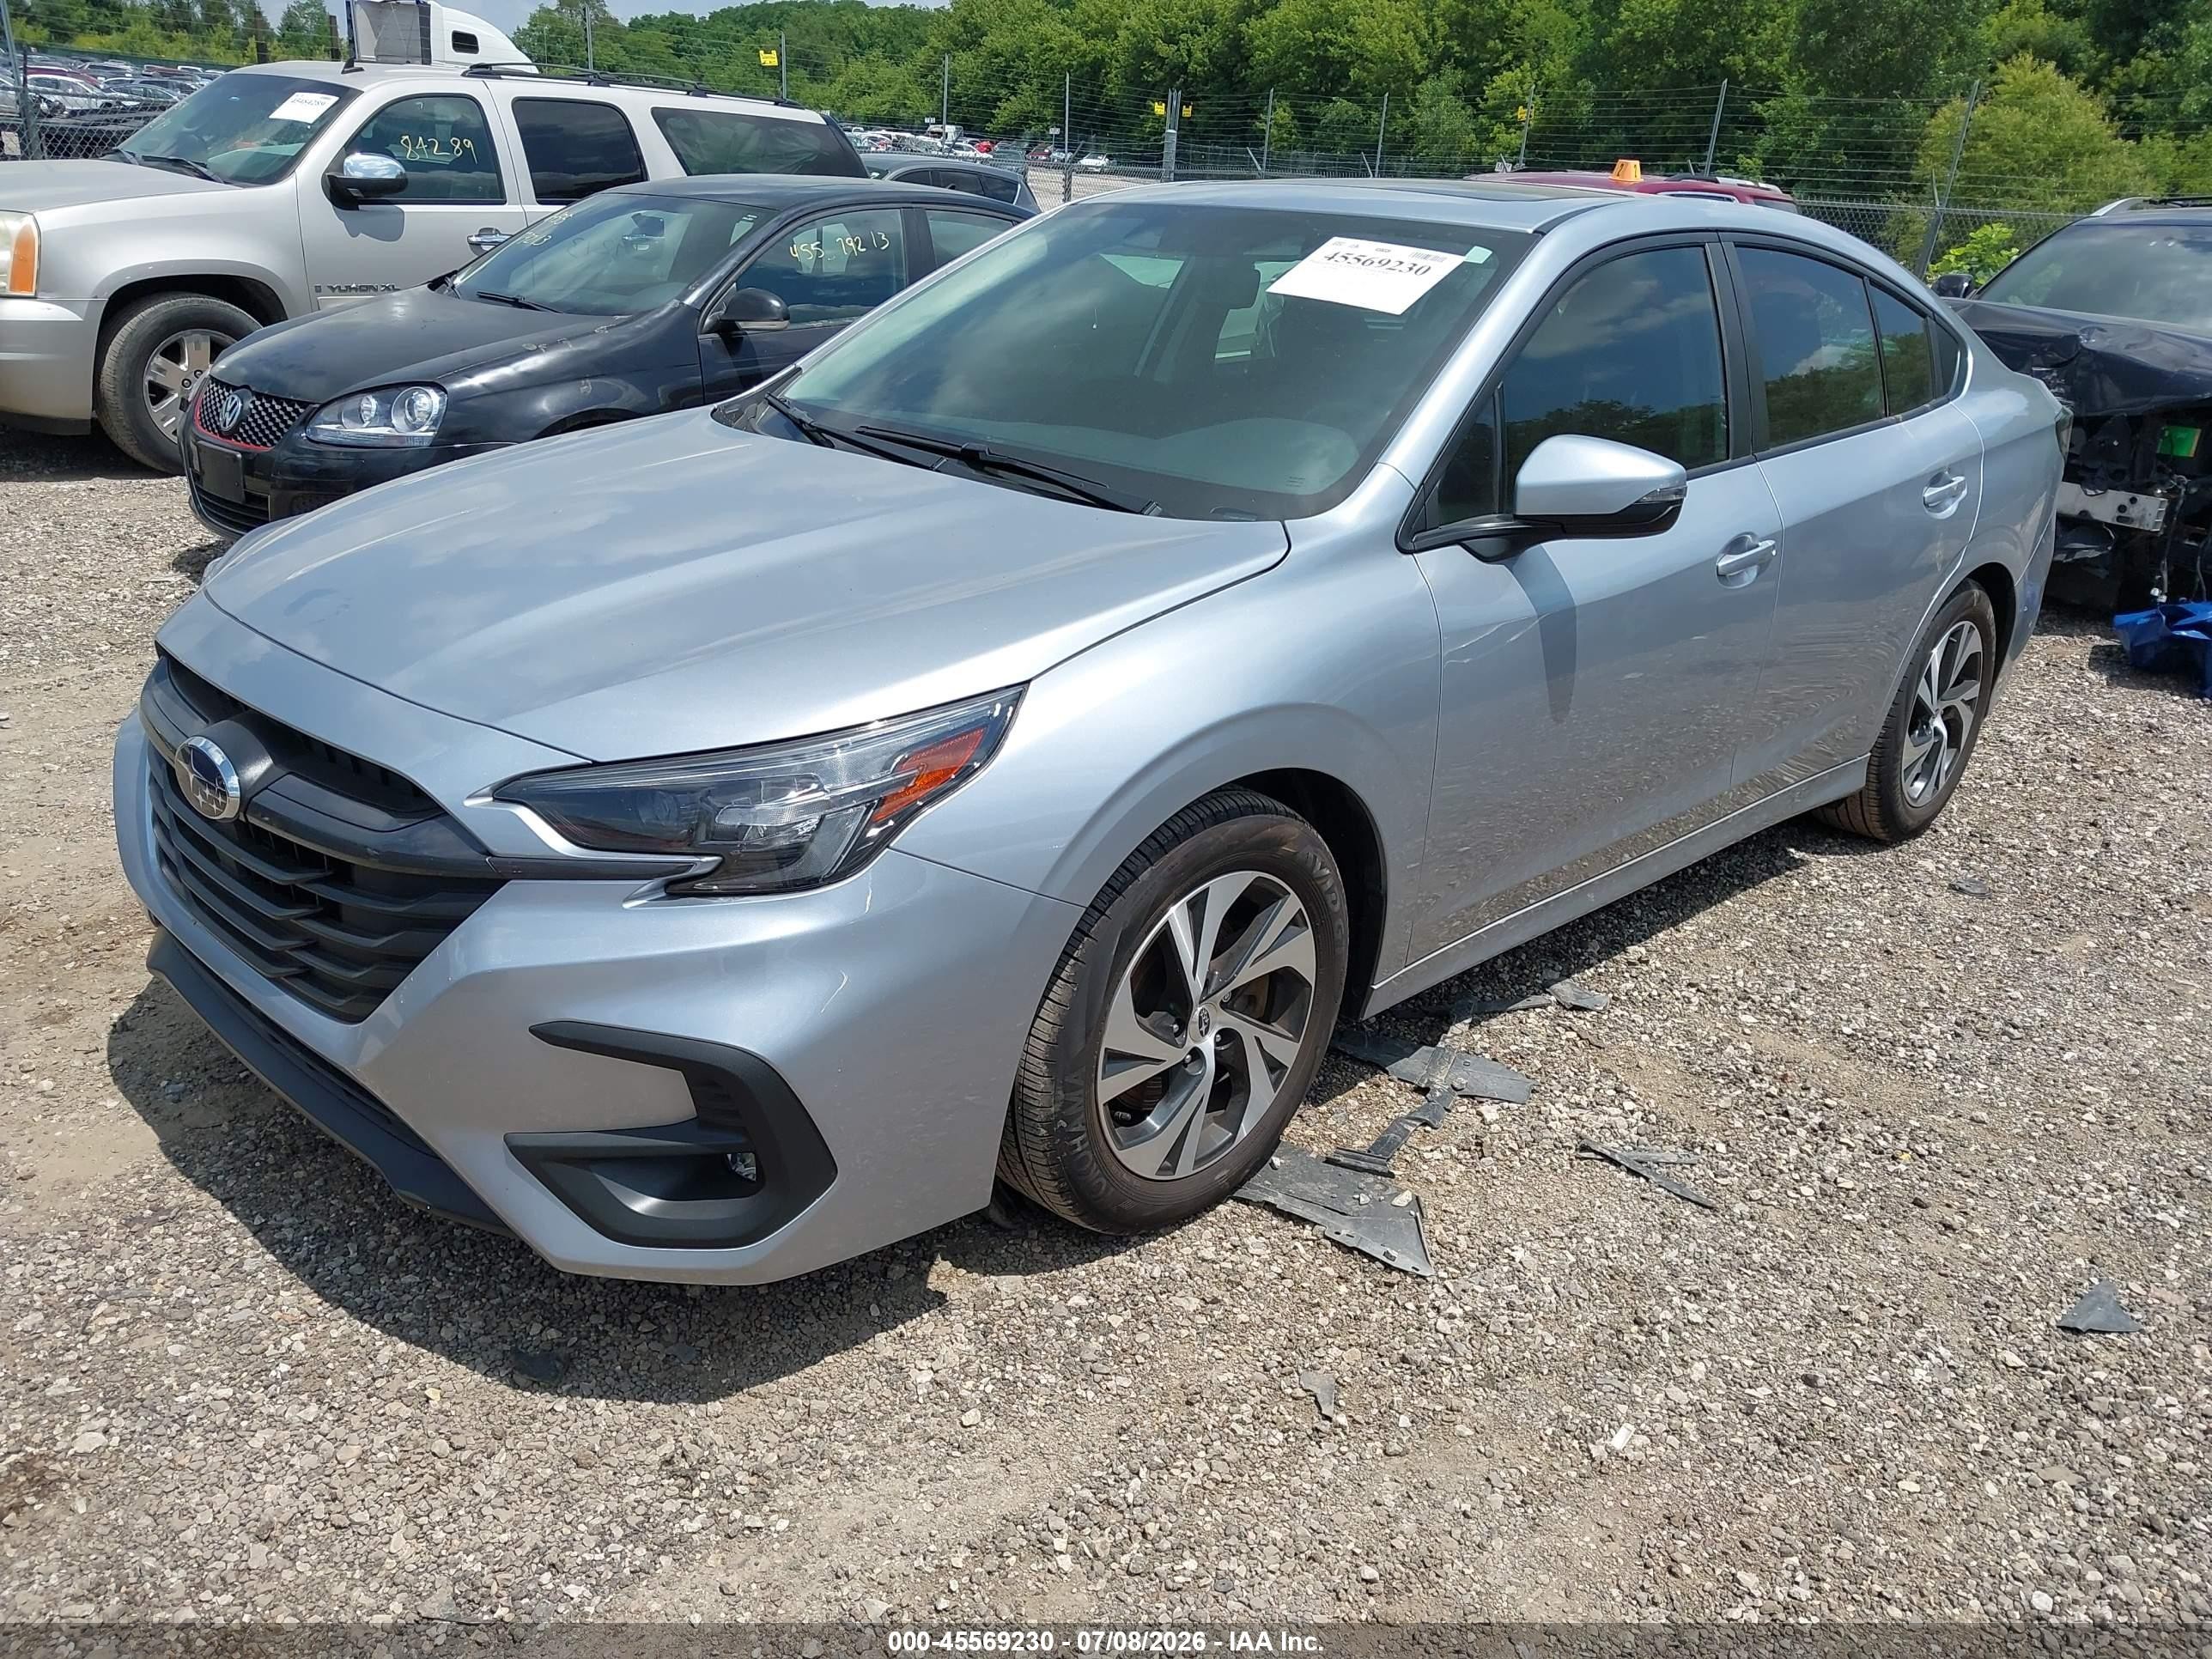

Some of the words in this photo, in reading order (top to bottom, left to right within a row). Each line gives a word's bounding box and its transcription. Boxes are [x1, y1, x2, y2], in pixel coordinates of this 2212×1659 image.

[400, 135, 477, 165] 84289
[1323, 251, 1431, 276] 45569230
[326, 284, 378, 293] YUKON
[380, 283, 401, 292] XL
